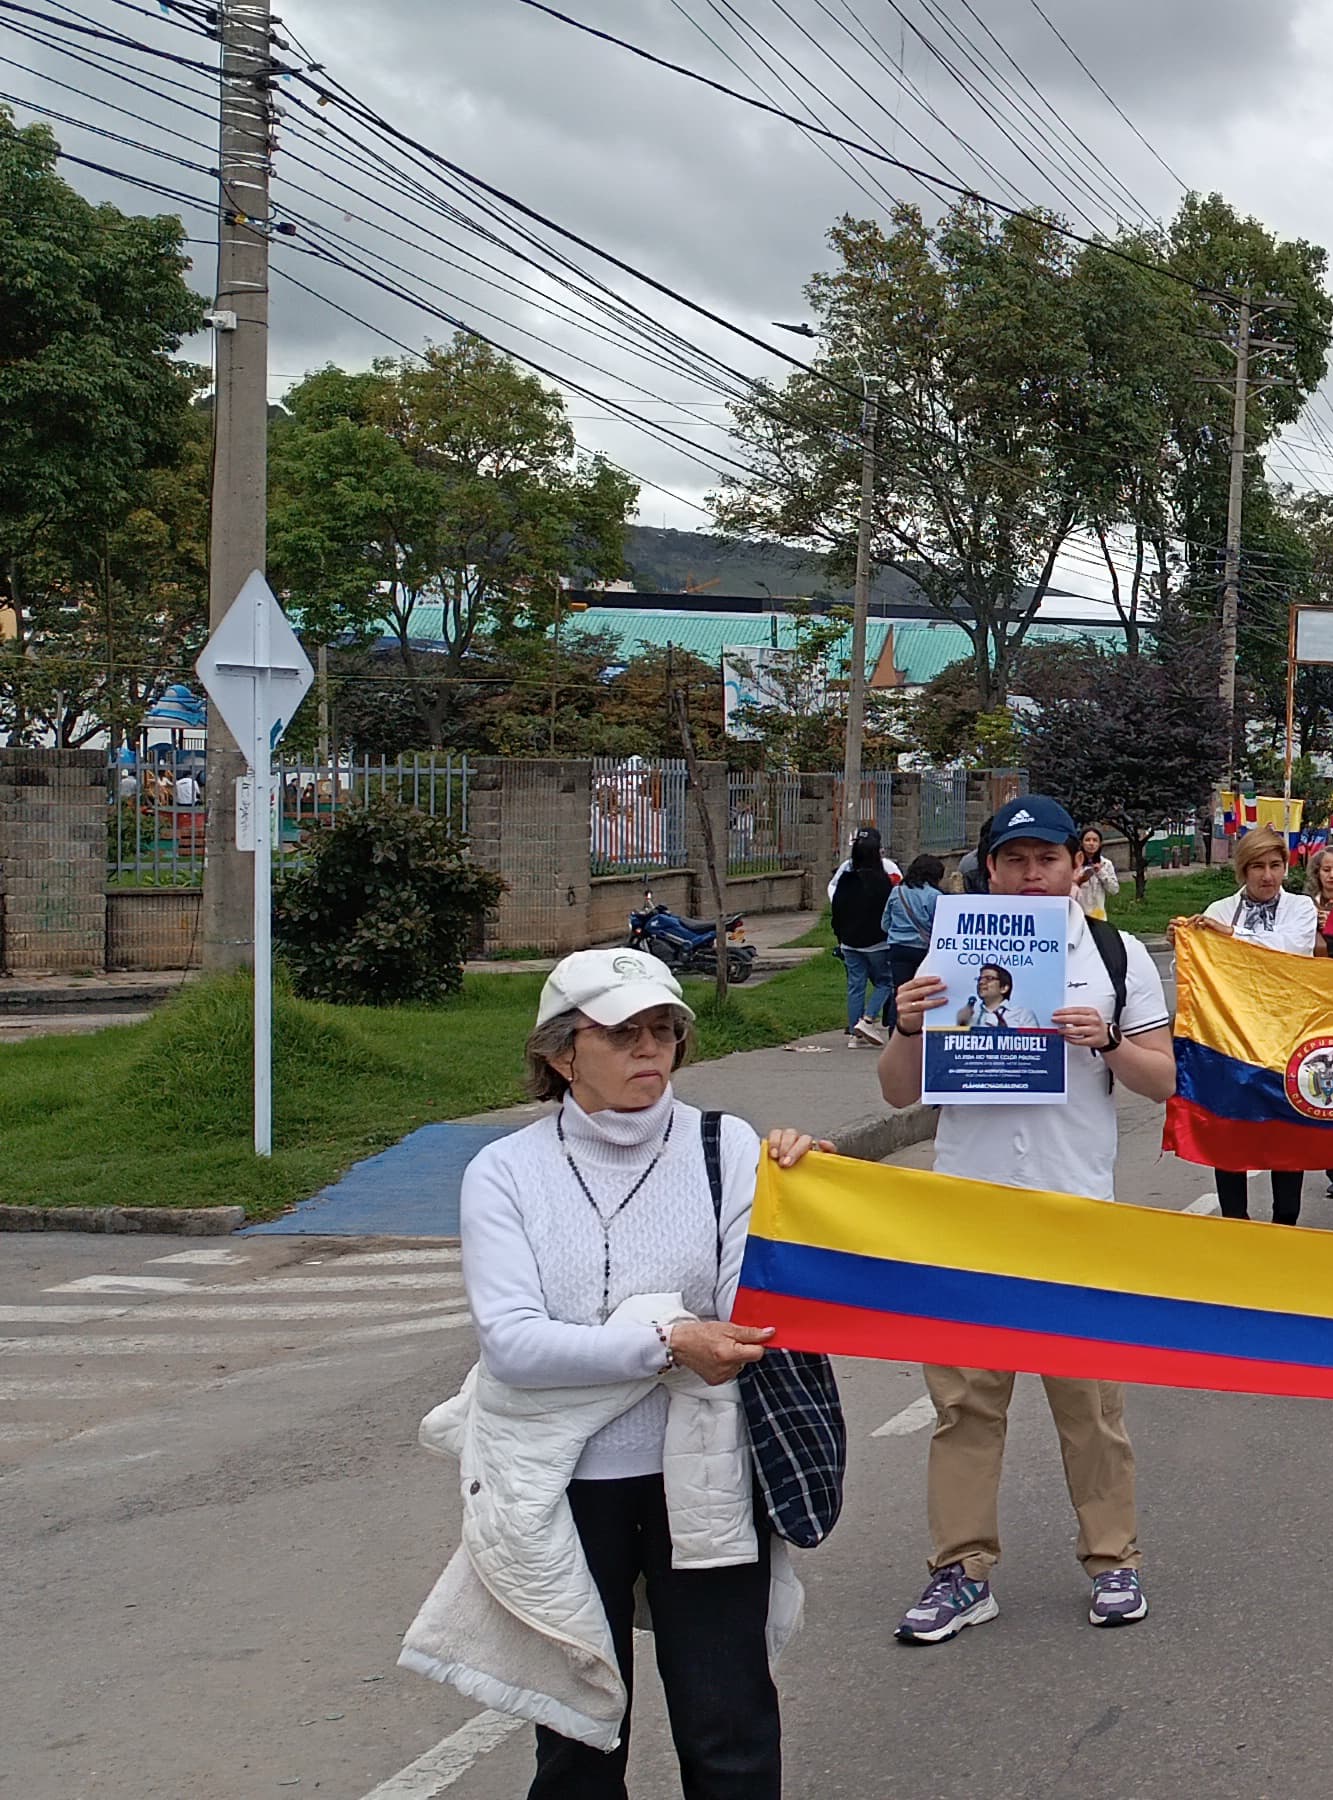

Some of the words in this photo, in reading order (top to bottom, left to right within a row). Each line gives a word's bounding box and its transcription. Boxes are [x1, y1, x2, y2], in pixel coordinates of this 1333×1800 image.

[957, 913, 1036, 936] MARCHA
[937, 938, 958, 950] DEL
[962, 938, 1025, 952] SILENCIO
[1030, 940, 1059, 953] POR
[957, 953, 1034, 966] COLOMBIA
[944, 1035, 994, 1051] ¡FUERZA
[997, 1036, 1048, 1052] MIGUEL!
